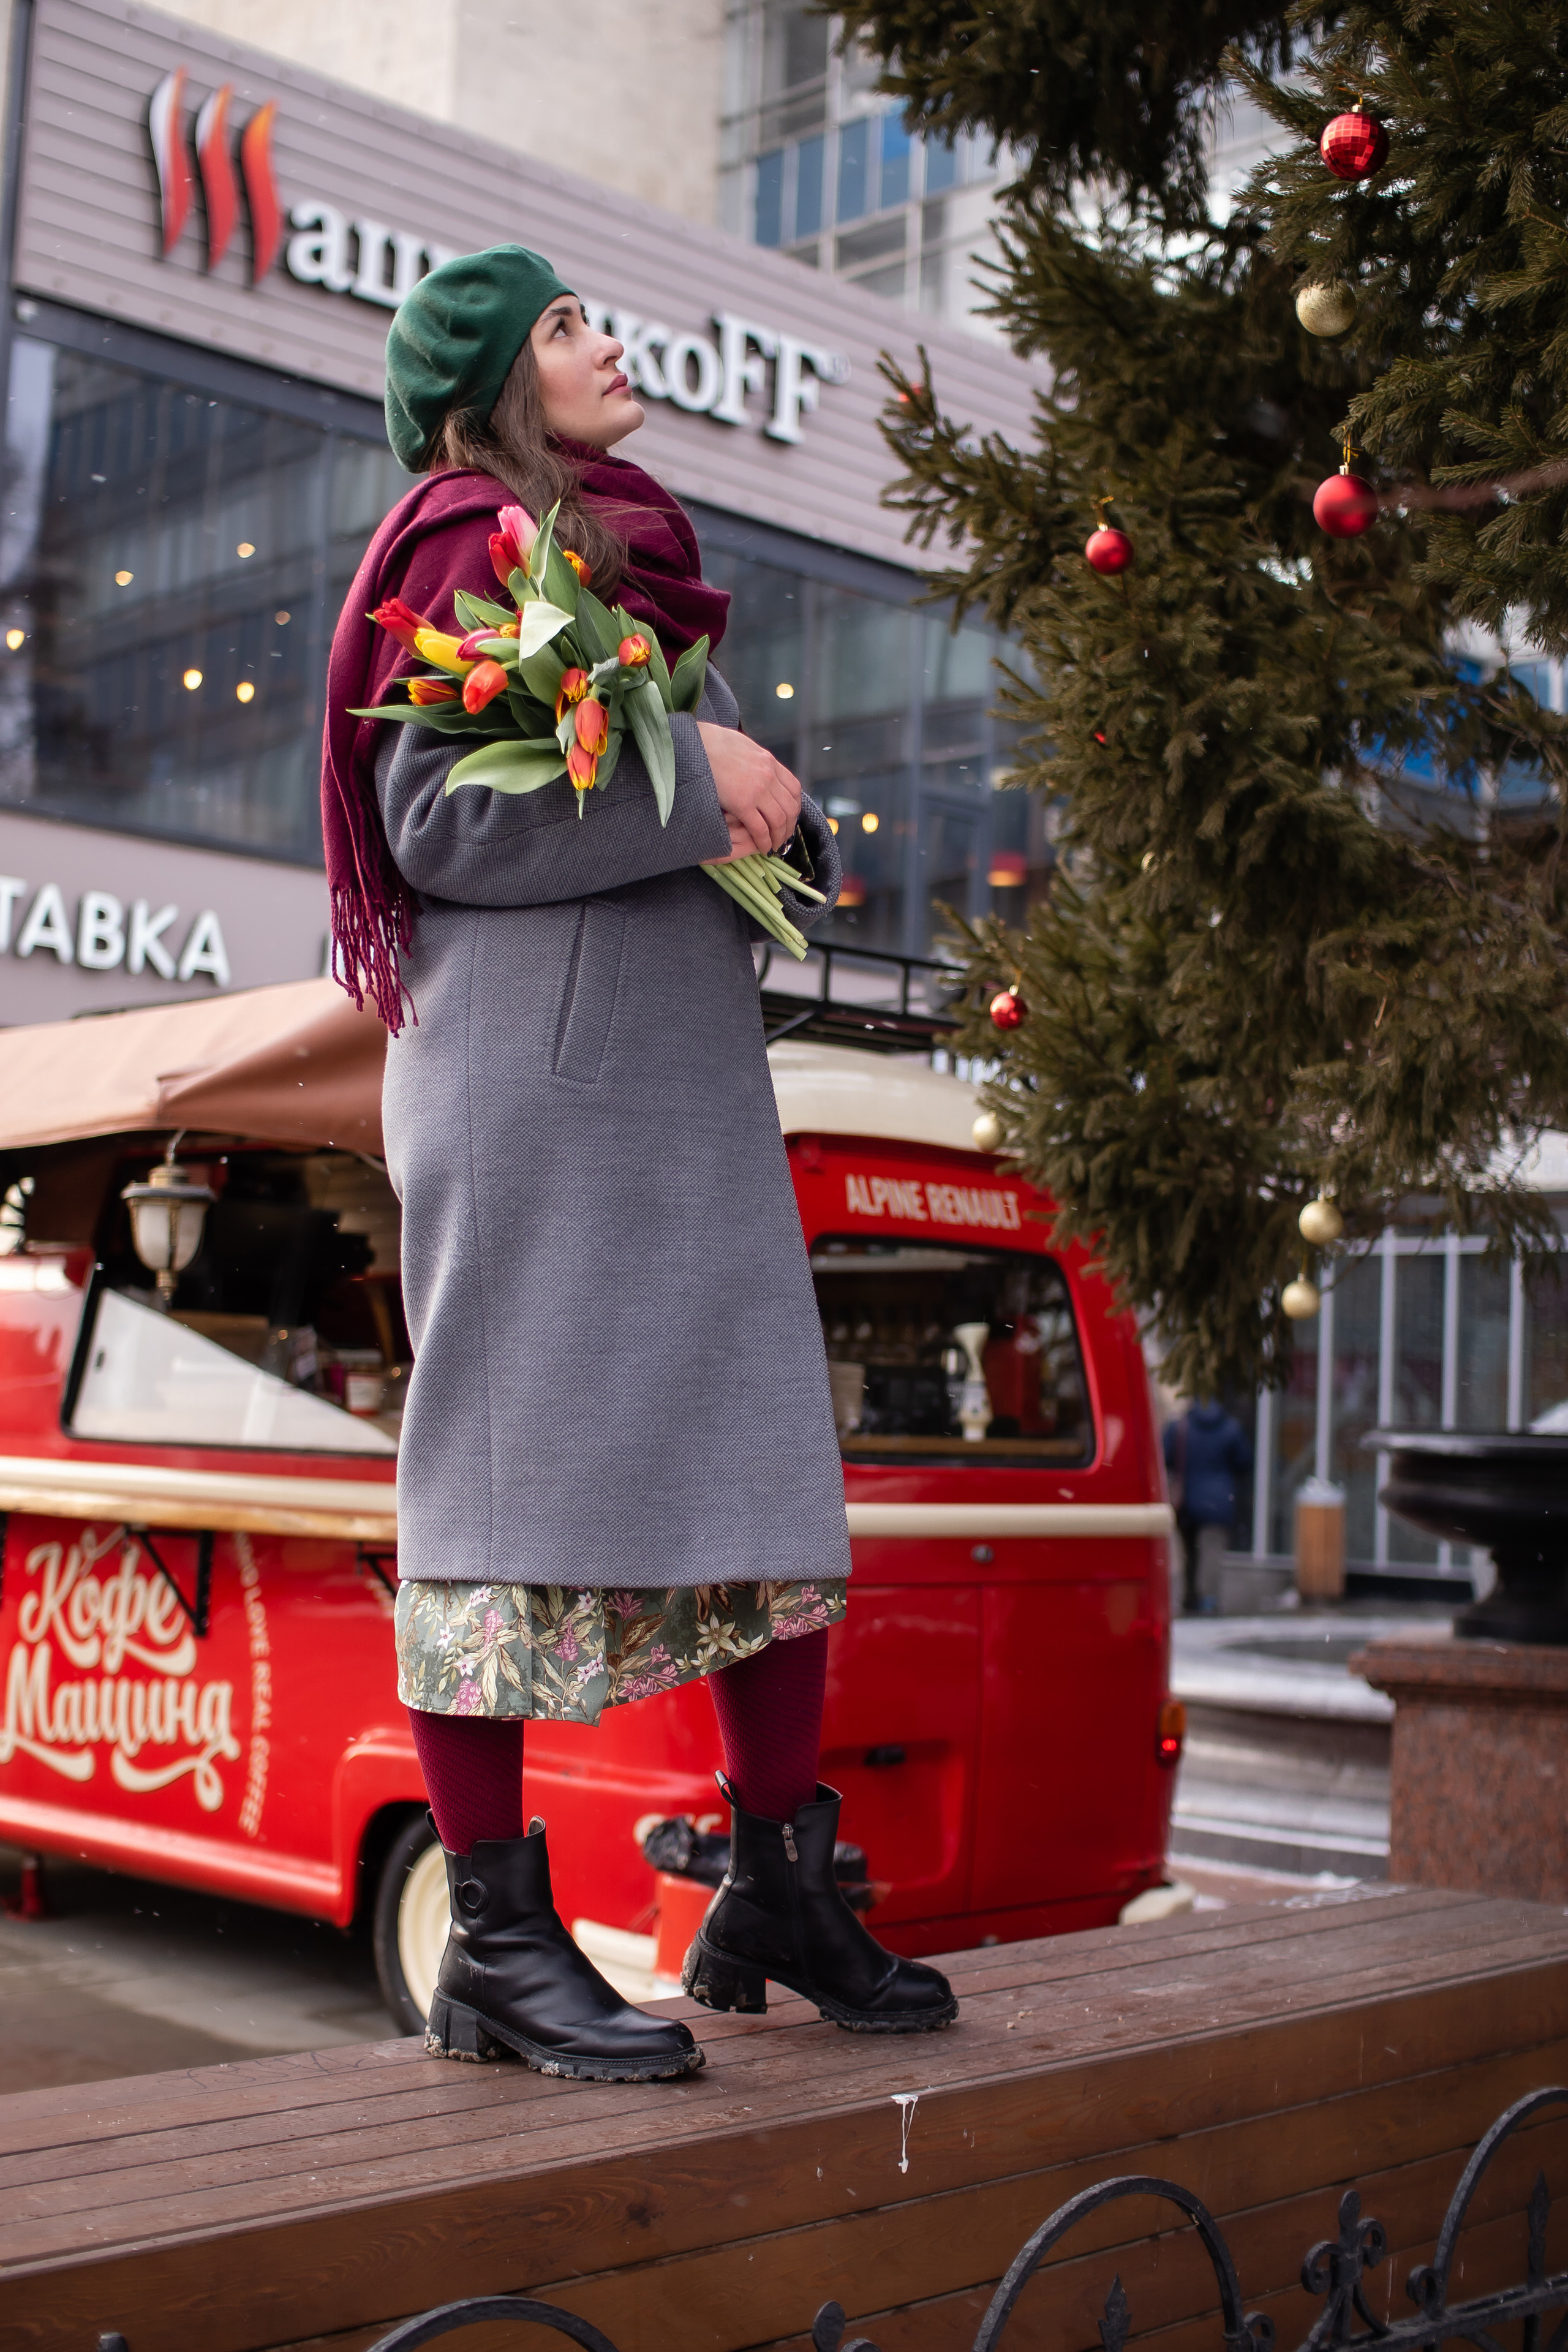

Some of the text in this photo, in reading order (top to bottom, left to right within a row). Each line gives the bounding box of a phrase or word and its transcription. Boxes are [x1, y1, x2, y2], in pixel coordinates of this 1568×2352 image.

[845, 1172, 1022, 1231] ALPINE RENAULT
[17, 1539, 197, 1676] Кофе
[0, 1642, 241, 1812] Машина
[251, 1660, 273, 1735] REAL
[238, 1734, 271, 1839] COFFEE
